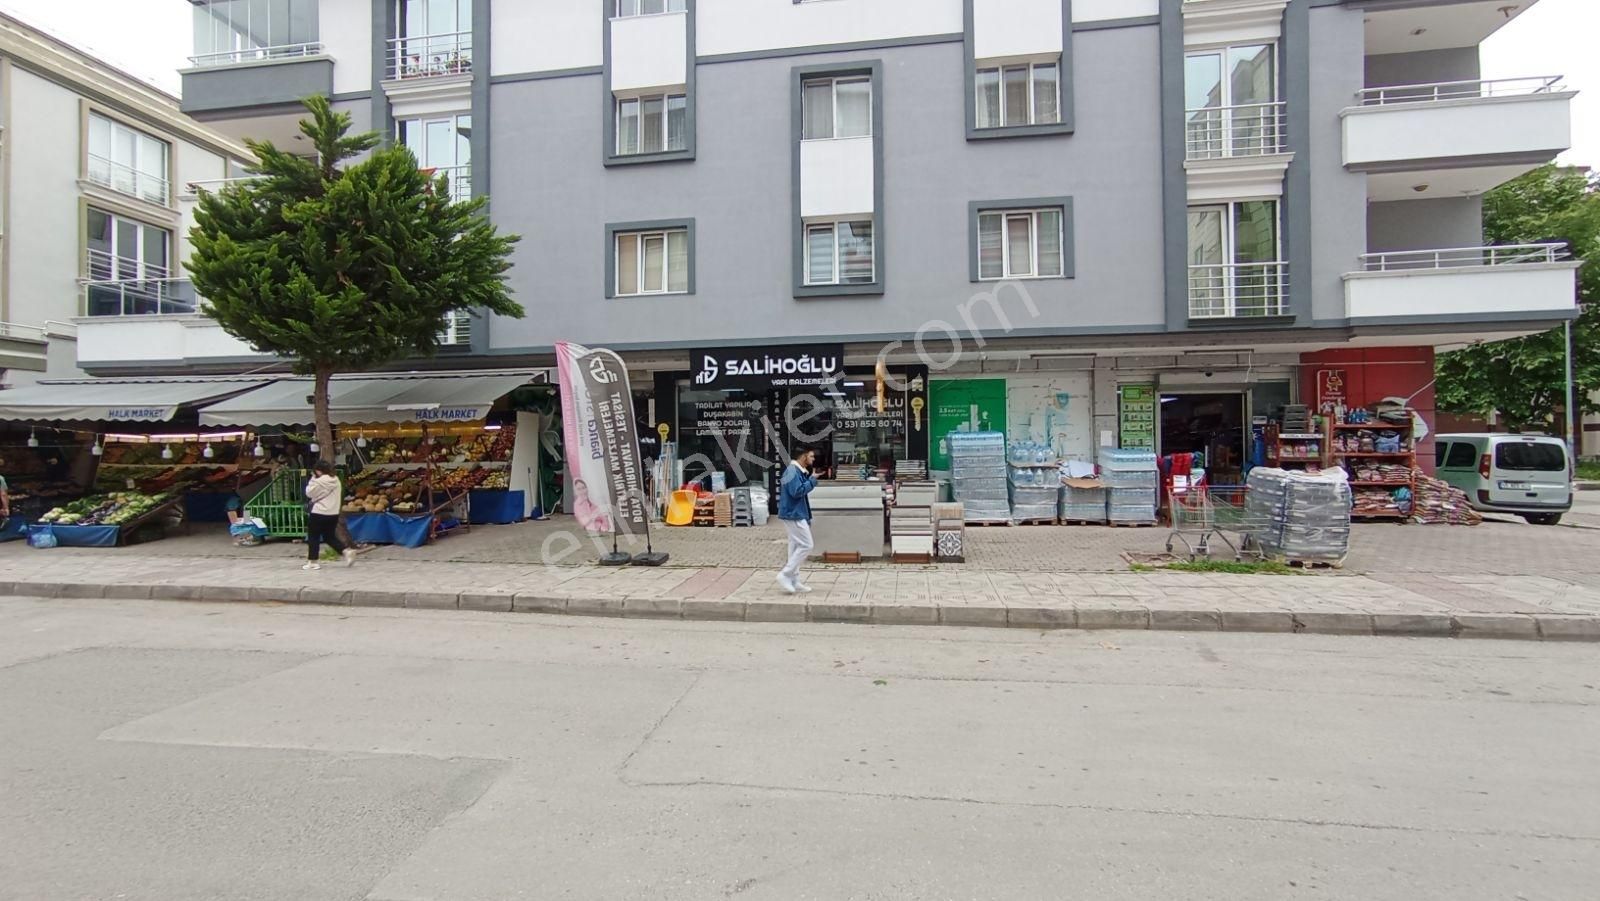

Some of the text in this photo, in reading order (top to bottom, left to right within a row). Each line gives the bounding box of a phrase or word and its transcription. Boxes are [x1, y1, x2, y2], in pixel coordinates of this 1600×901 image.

[725, 354, 836, 375] SALİHOĞLU
[771, 376, 837, 386] YAPI MALZEMELERİ
[108, 409, 165, 419] HALK MARKET
[415, 408, 478, 420] HALK MARKET
[836, 419, 903, 428] 0 531 858 80 74
